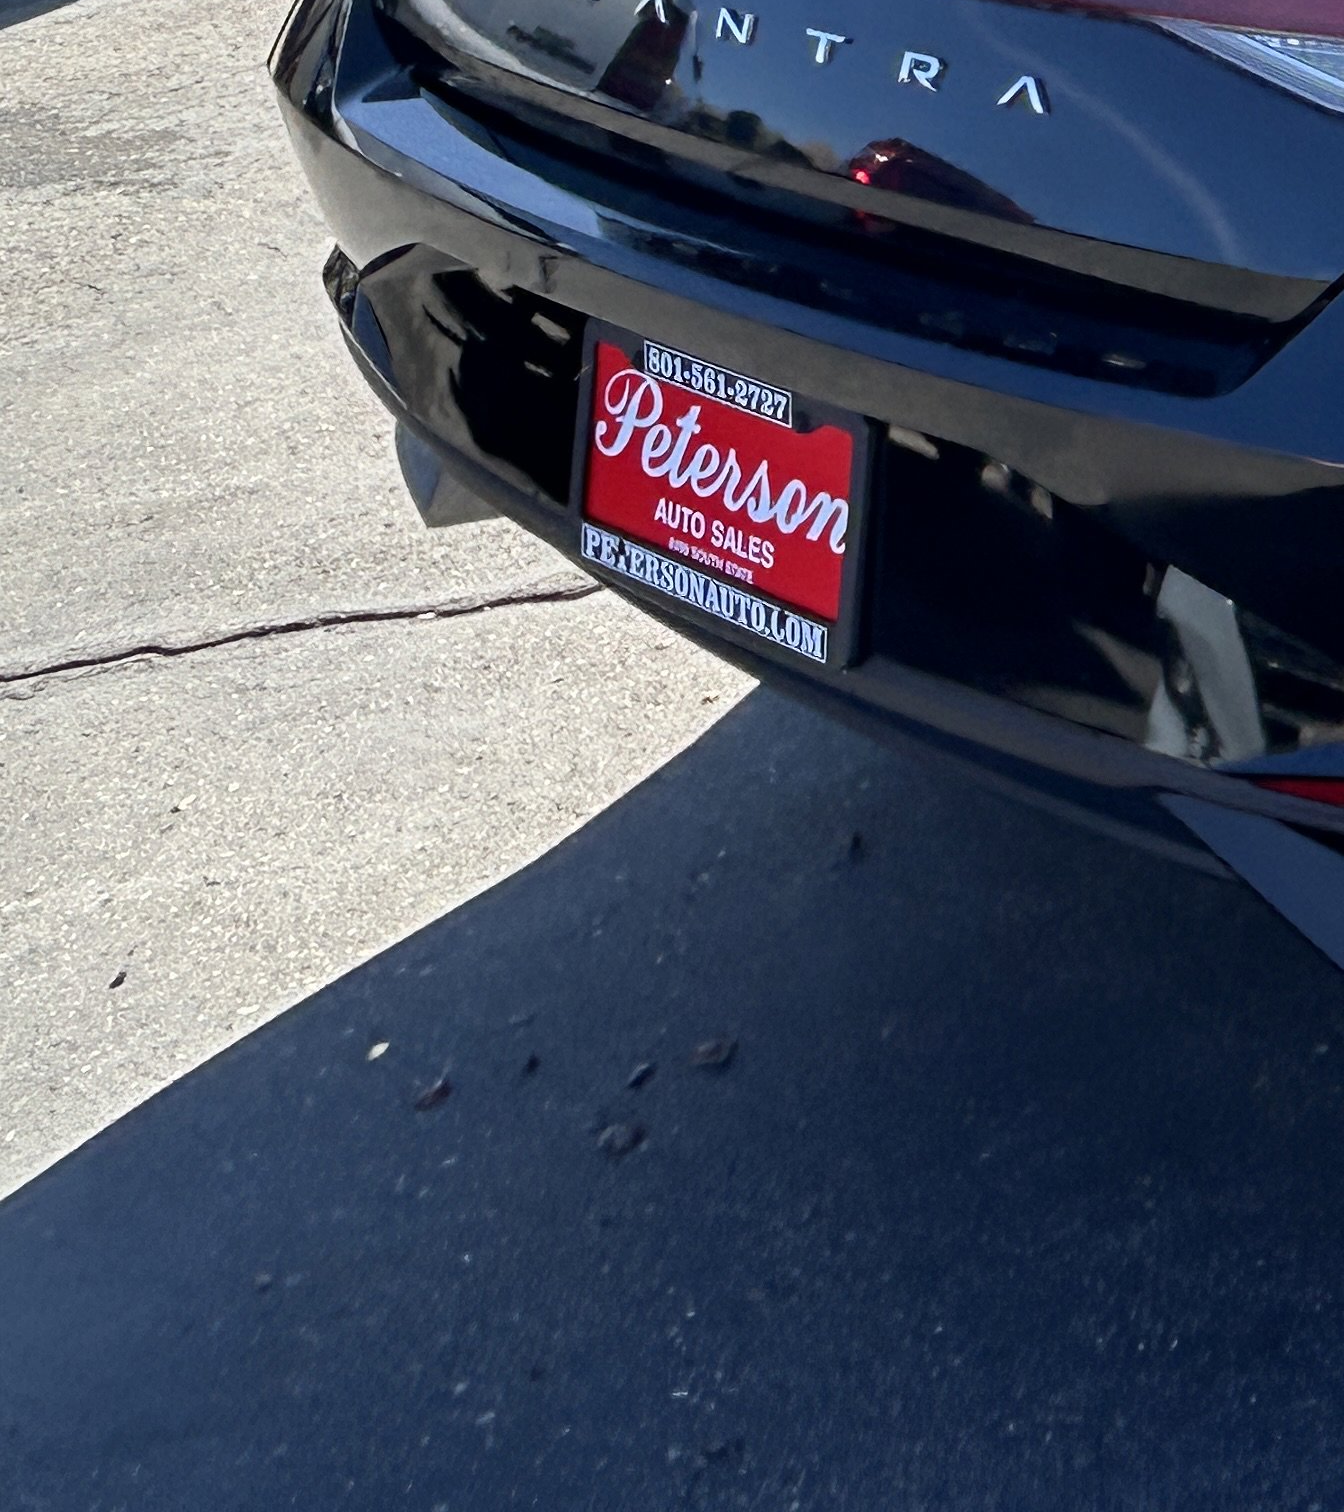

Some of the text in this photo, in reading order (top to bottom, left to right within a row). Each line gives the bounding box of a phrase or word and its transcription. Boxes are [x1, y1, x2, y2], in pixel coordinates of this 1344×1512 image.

[595, 368, 849, 555] Peterson
[654, 498, 706, 539] AUTO
[711, 519, 775, 569] SALES
